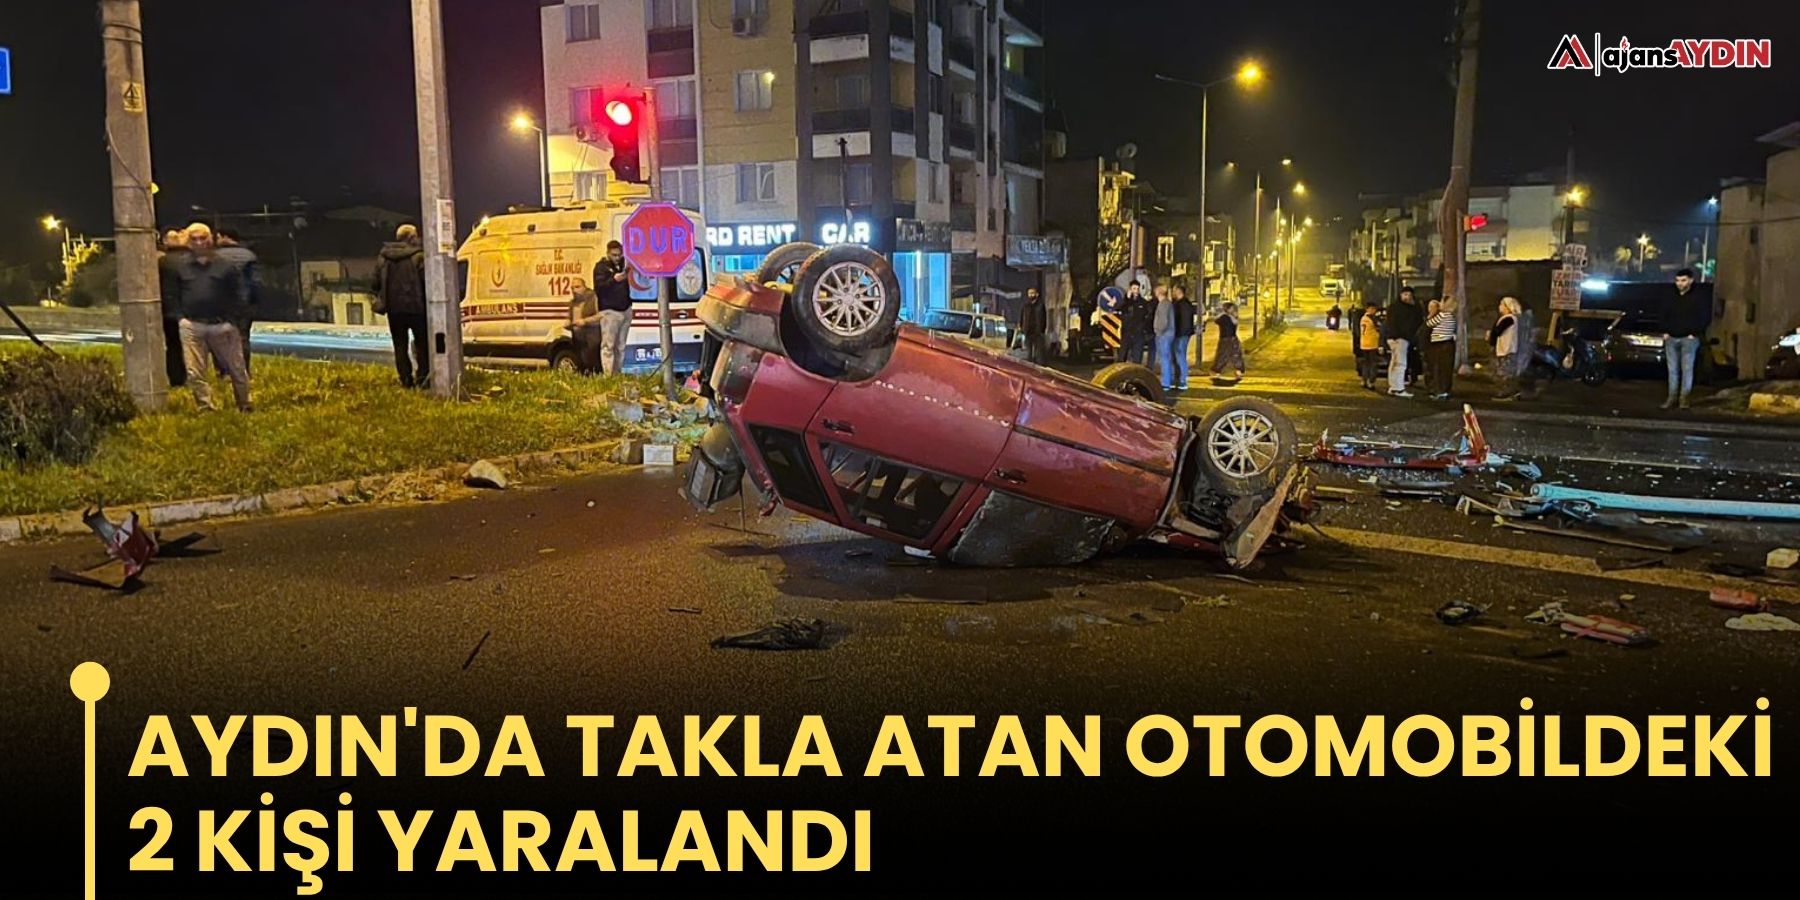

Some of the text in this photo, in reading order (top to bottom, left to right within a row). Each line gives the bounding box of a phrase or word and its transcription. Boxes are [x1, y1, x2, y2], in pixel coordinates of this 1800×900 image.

[629, 226, 687, 254] DUR
[738, 223, 796, 246] RENT
[821, 221, 871, 244] CAR
[548, 277, 571, 296] 112
